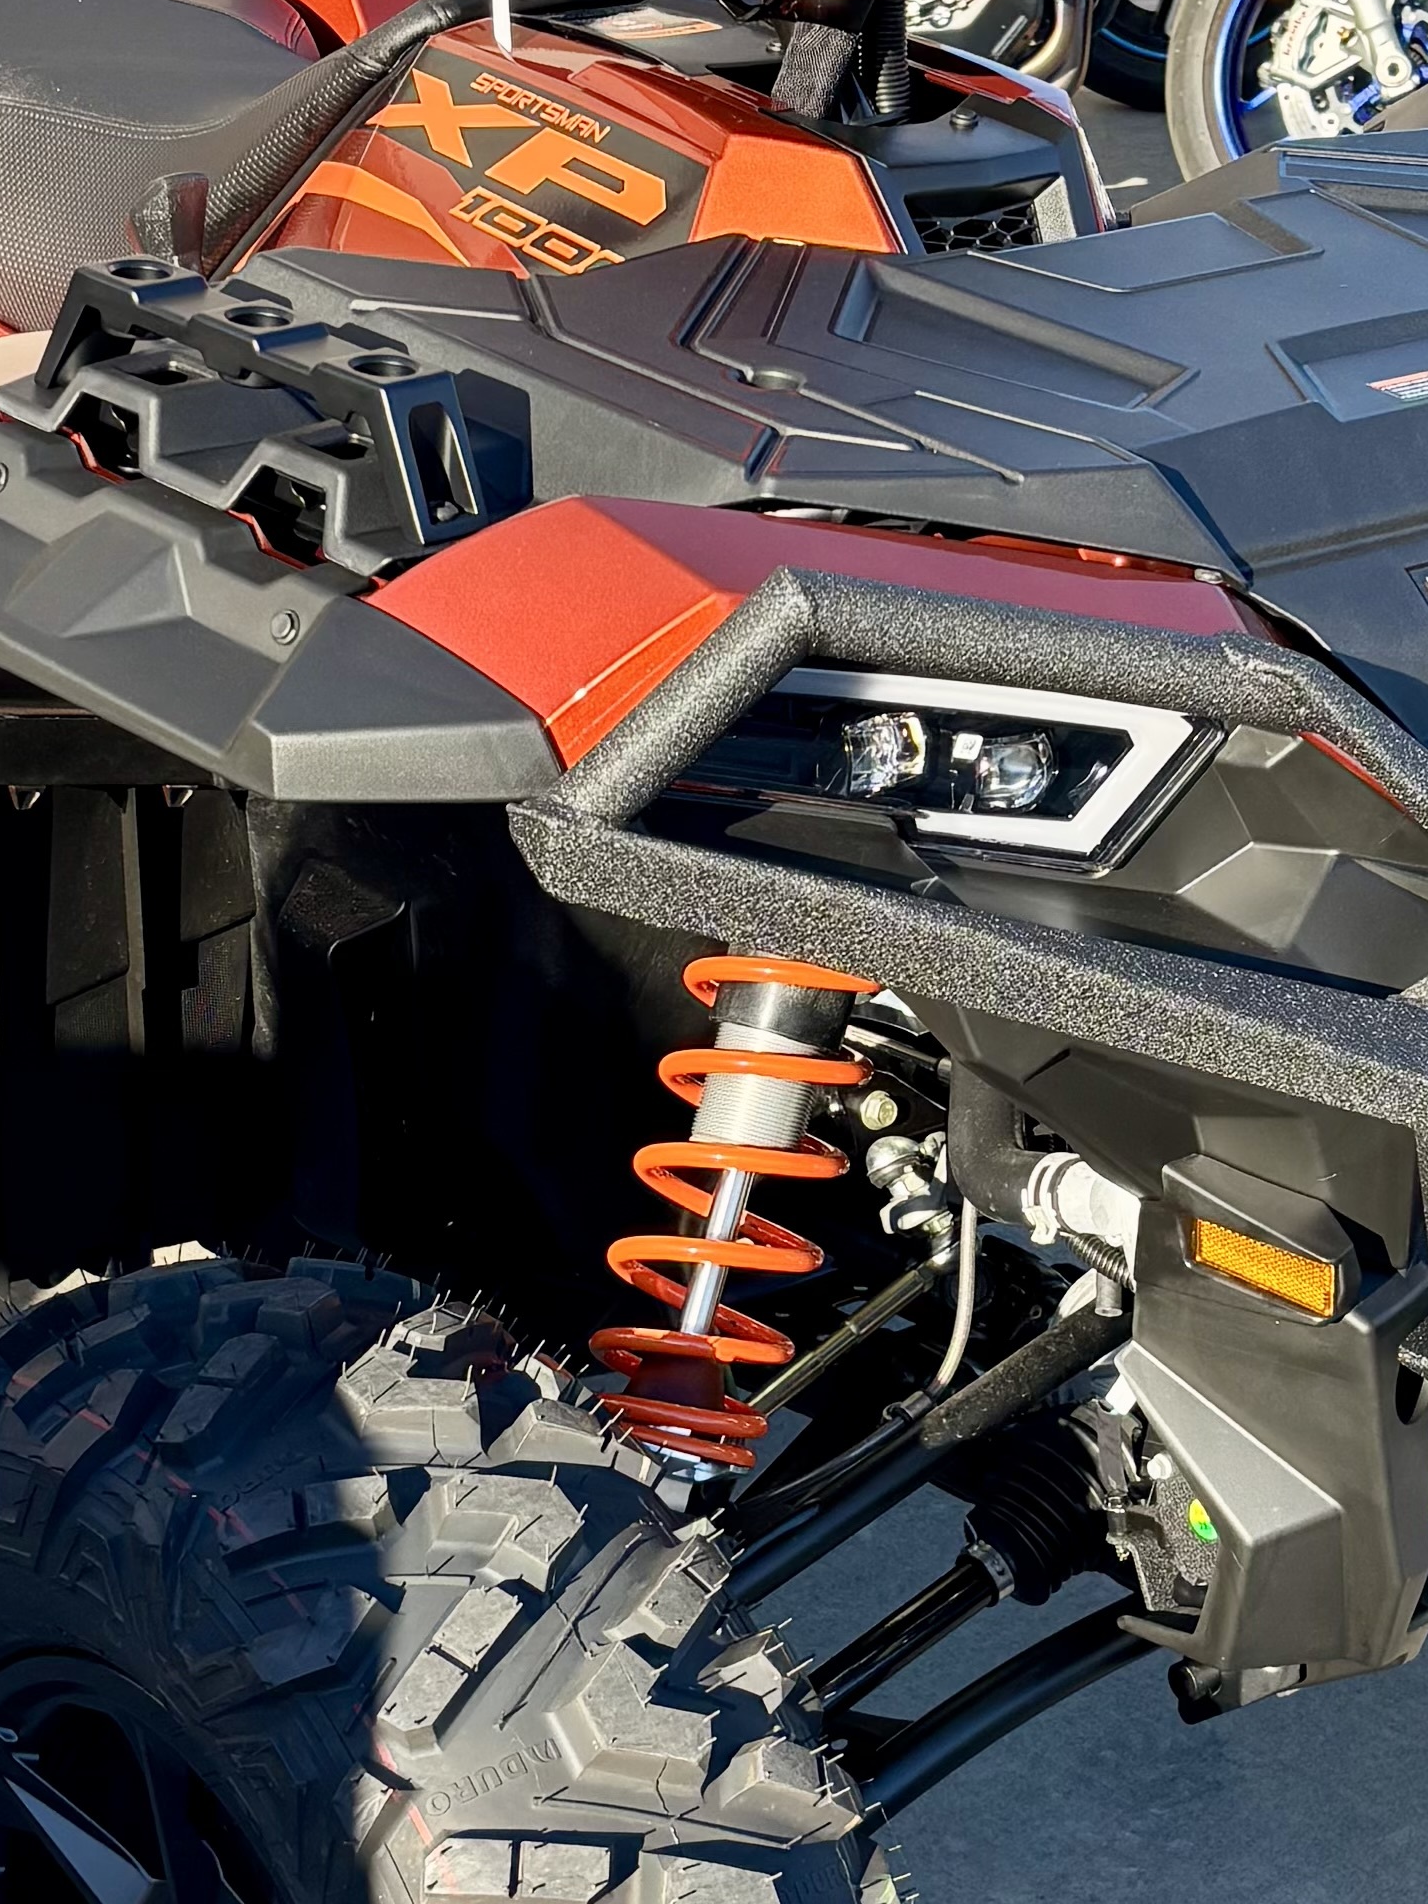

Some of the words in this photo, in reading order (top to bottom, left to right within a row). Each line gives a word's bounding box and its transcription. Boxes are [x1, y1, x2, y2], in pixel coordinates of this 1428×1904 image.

[365, 68, 668, 227] XP
[469, 72, 612, 144] SPORTSMAN
[448, 186, 626, 275] 100
[425, 1751, 529, 1817] DURO
